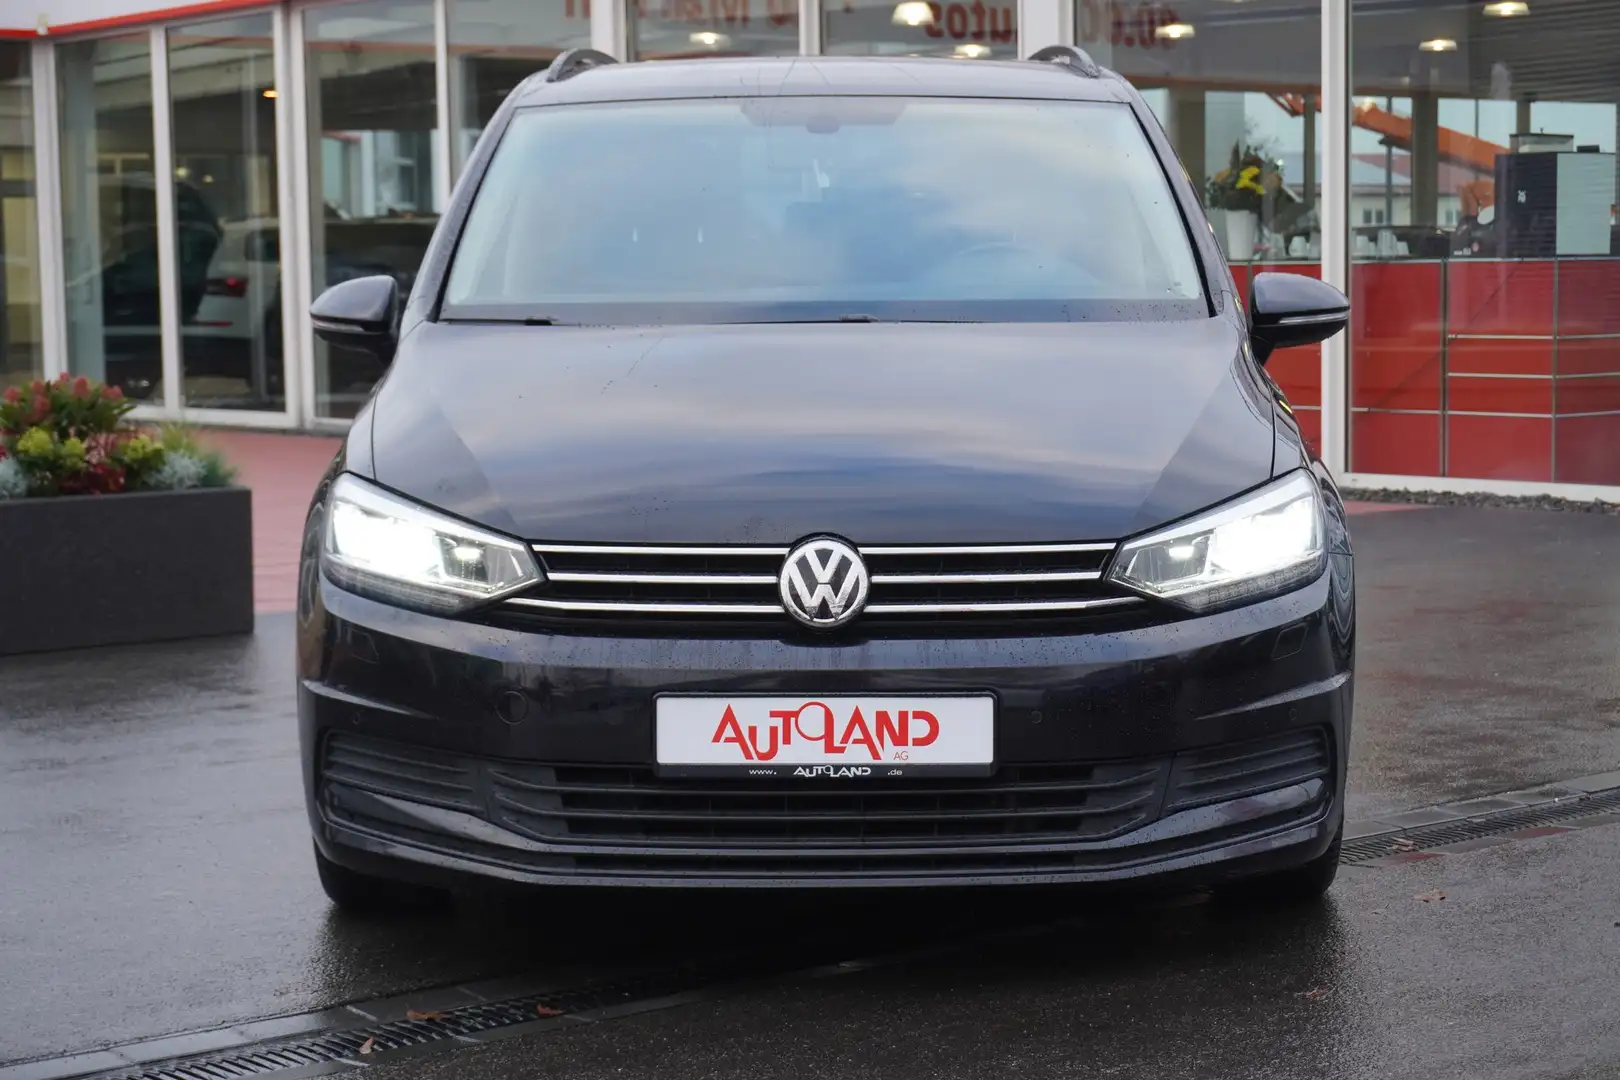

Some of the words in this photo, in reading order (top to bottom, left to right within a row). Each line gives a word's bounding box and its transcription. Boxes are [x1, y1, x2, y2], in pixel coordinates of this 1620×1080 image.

[780, 539, 868, 627] VW
[893, 751, 909, 761] AG
[887, 768, 903, 776] .de
